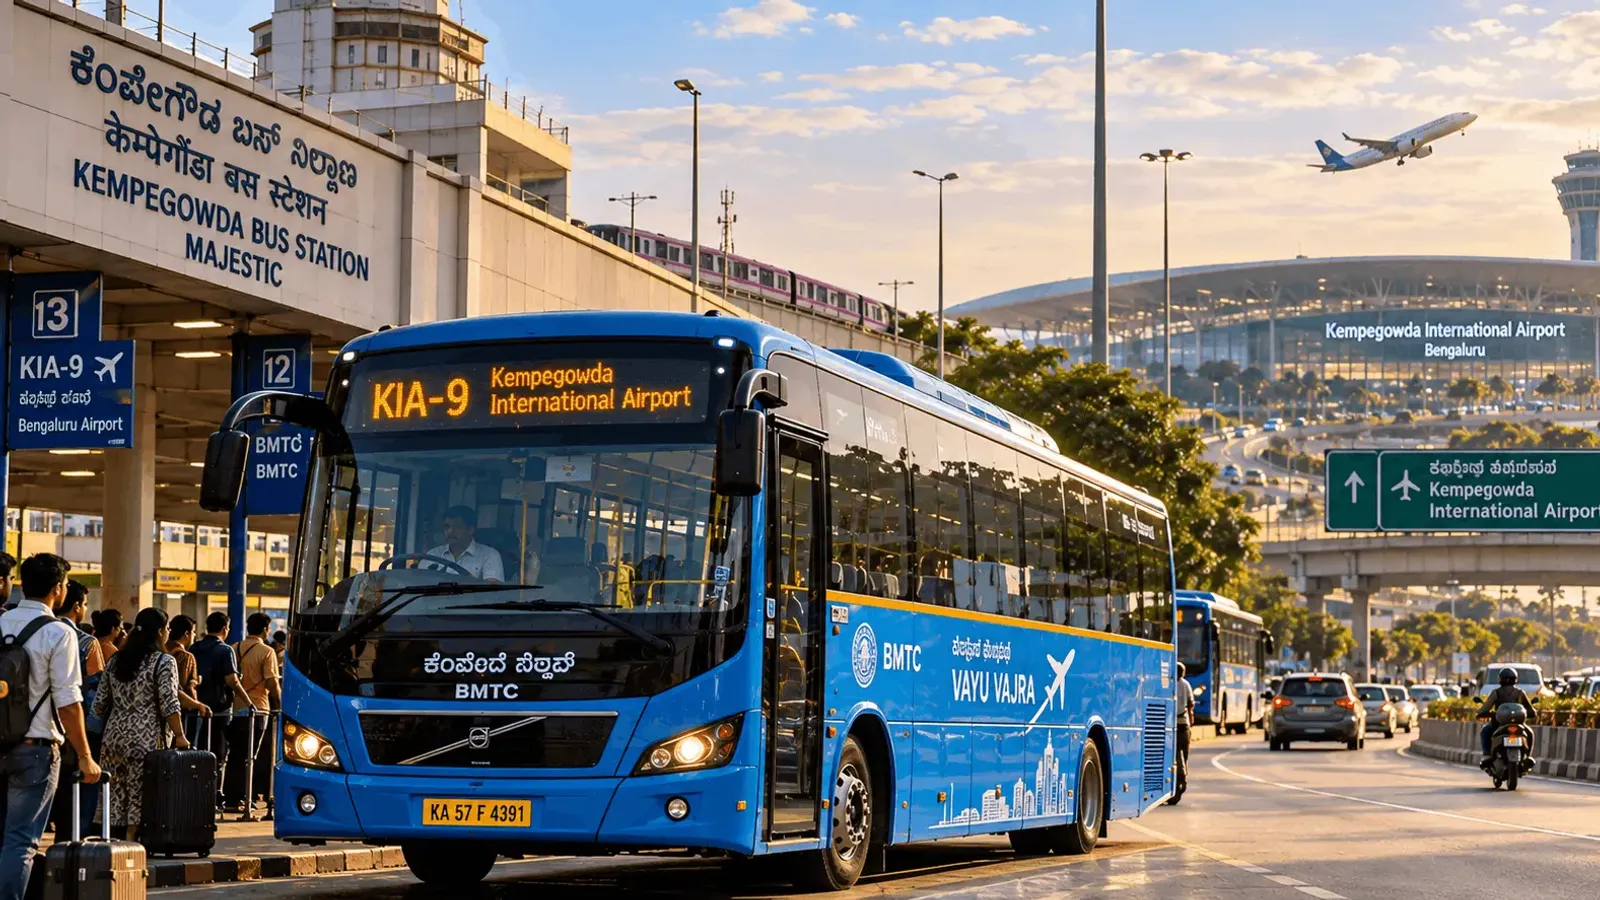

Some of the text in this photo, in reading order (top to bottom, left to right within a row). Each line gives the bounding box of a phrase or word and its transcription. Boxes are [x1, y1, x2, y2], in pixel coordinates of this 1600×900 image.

[233, 115, 281, 154] ಬಸ್
[224, 162, 261, 200] बस
[268, 175, 328, 225] स्टेशन
[74, 158, 369, 281] KEMPEGOWDA BUS STATION
[185, 232, 283, 288] MAJESTIC
[35, 297, 69, 332] 13
[1325, 321, 1566, 341] Kempegowda International Airport
[1424, 342, 1486, 360] Bengaluru
[19, 354, 83, 379] KIA-9
[264, 354, 291, 383] 12
[491, 362, 613, 390] Kempegowda
[372, 377, 469, 419] KIA-9
[490, 385, 691, 415] International Airport
[18, 417, 123, 435] Bengaluru Airport
[256, 463, 298, 479] BMTC
[1430, 481, 1534, 500] Kempegowda
[1429, 502, 1538, 518] International
[883, 642, 922, 672] BMTC
[455, 683, 519, 699] BMTC
[951, 668, 1036, 705] VAYU VAJRA
[431, 804, 524, 822] KA 57 F 4391
